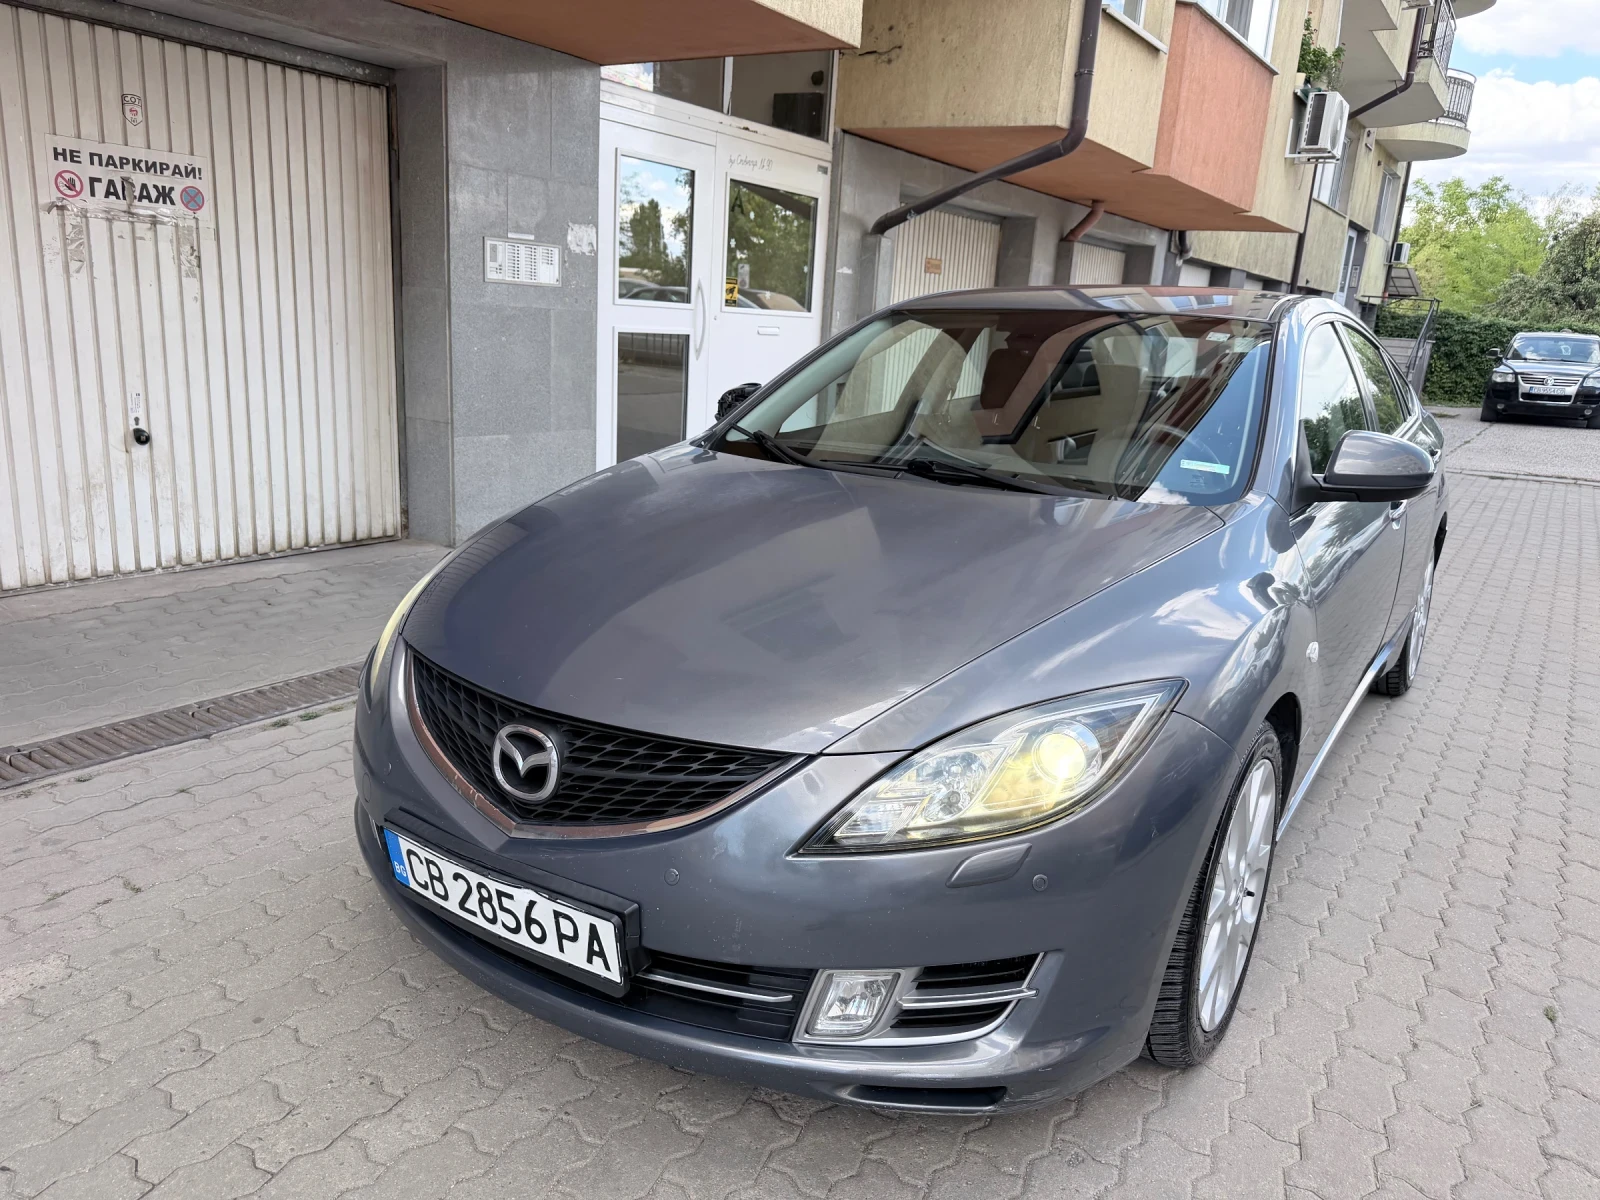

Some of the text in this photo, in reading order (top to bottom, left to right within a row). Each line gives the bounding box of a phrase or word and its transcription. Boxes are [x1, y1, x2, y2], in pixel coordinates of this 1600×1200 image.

[123, 95, 141, 105] СОТ
[53, 147, 203, 180] НЕ ПАРКИРАЙ!
[394, 861, 407, 876] BG
[406, 848, 612, 972] CB 2856 PA
